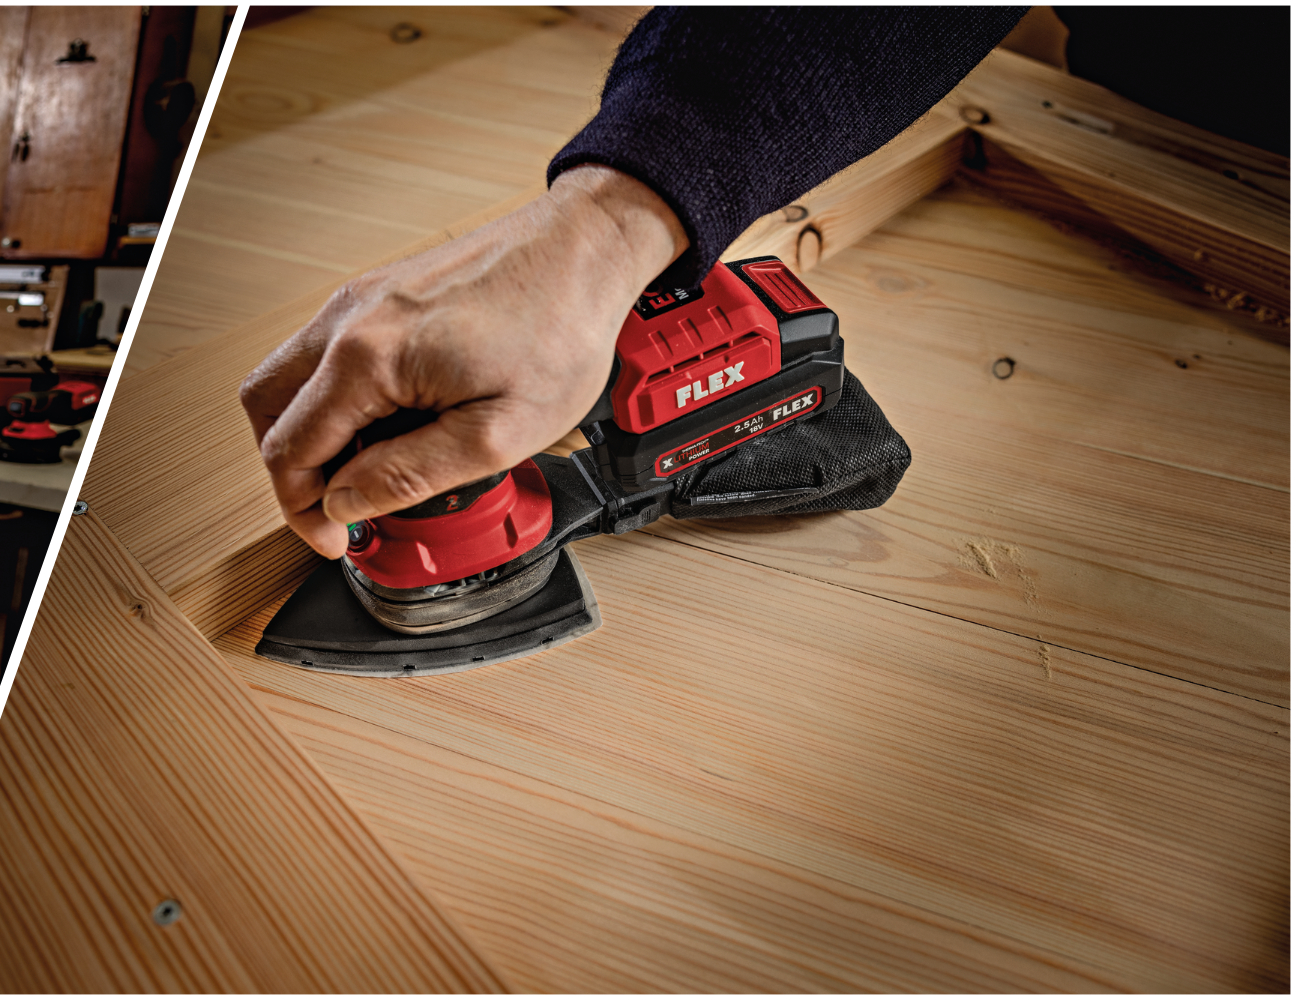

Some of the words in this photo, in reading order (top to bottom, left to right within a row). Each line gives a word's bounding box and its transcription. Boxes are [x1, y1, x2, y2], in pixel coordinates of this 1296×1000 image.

[676, 361, 745, 408] FLEX
[773, 393, 814, 421] FLEX
[749, 423, 764, 434] 18V
[673, 442, 710, 463] LITHIUM
[688, 448, 710, 461] POWER
[446, 494, 459, 511] 2
